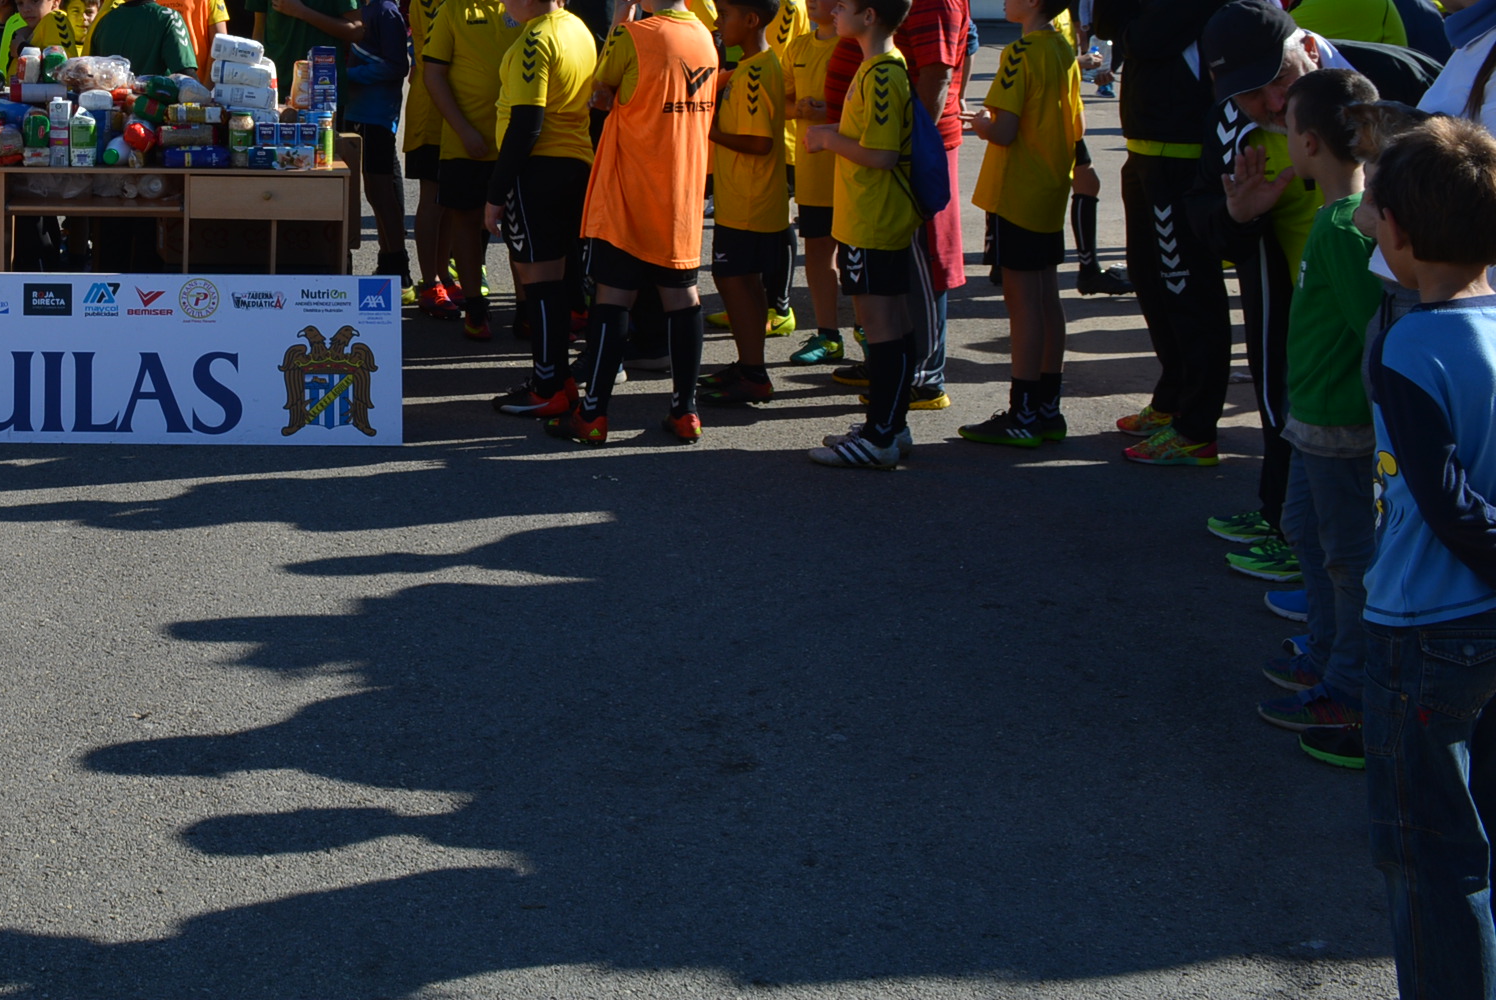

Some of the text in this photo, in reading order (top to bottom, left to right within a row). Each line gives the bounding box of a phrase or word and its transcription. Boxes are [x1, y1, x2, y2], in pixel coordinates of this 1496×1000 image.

[32, 290, 55, 298] ROJA
[359, 295, 386, 308] AXA
[84, 305, 119, 313] maycol
[127, 308, 174, 316] BEMISER
